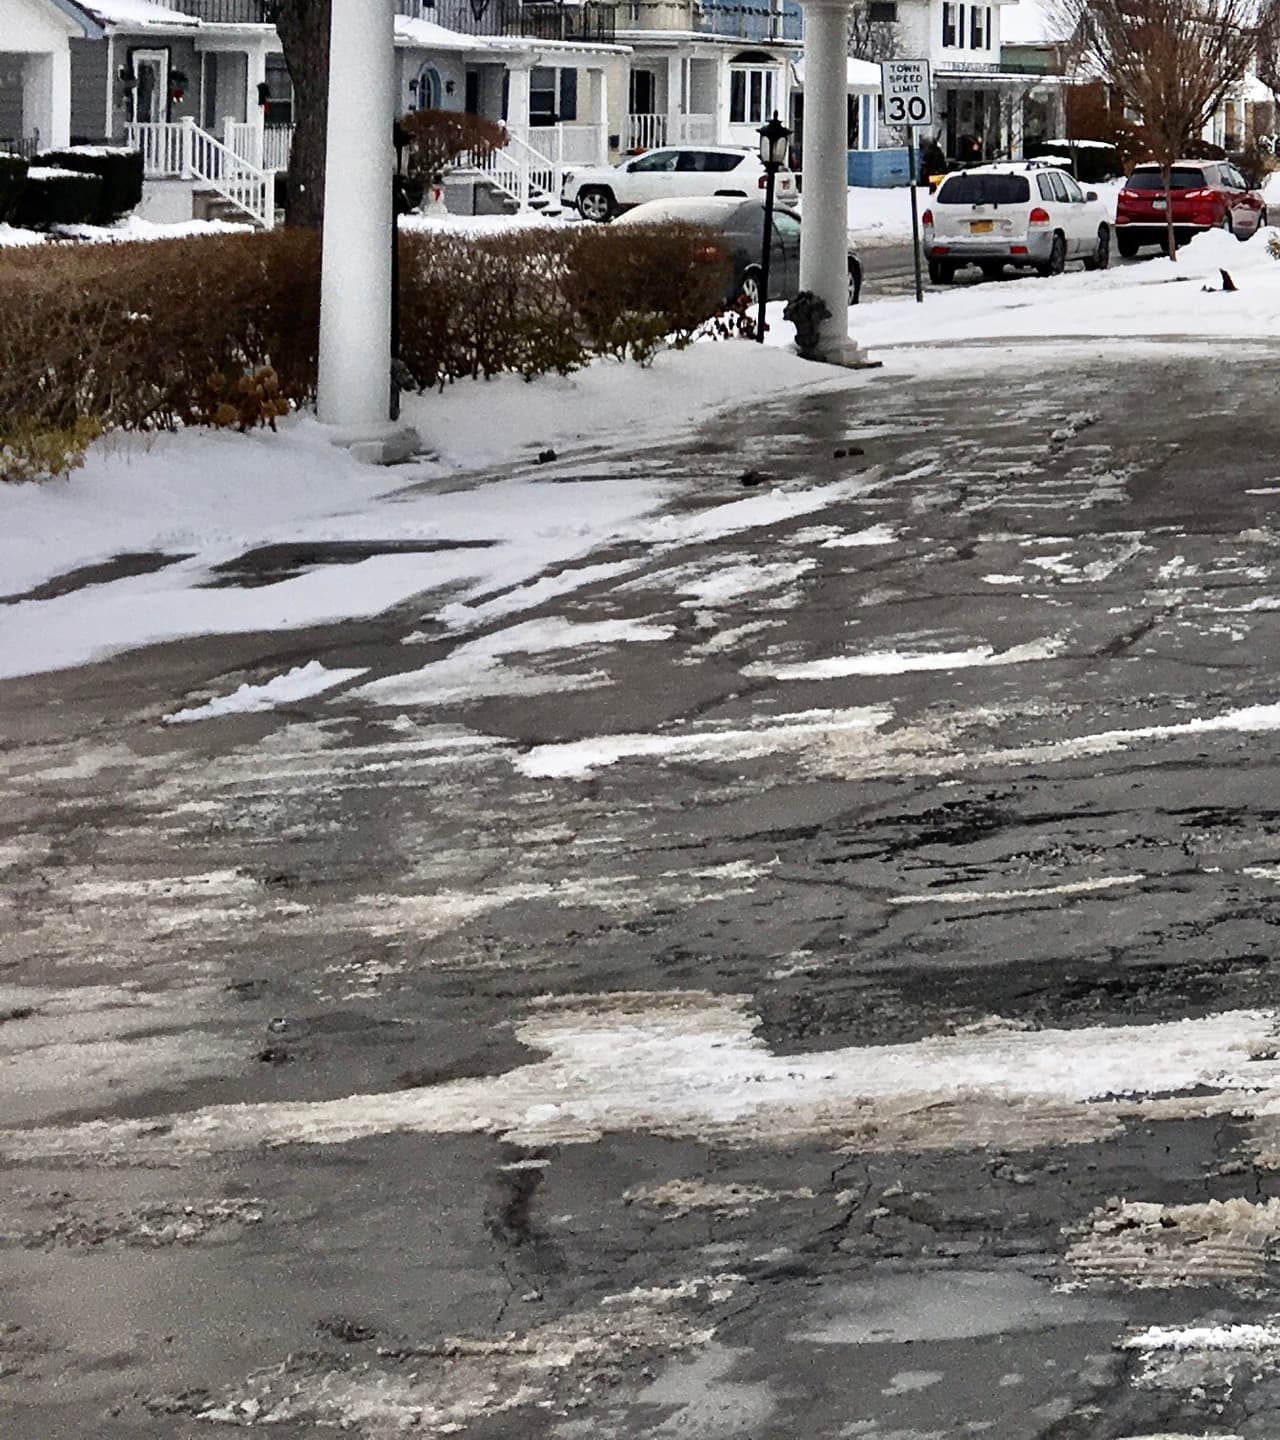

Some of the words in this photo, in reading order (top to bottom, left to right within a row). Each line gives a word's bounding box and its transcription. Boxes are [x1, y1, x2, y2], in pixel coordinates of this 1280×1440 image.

[889, 64, 920, 72] TOWN
[889, 74, 923, 83] SPEED
[892, 85, 919, 93] LIMIT
[889, 96, 926, 120] 30
